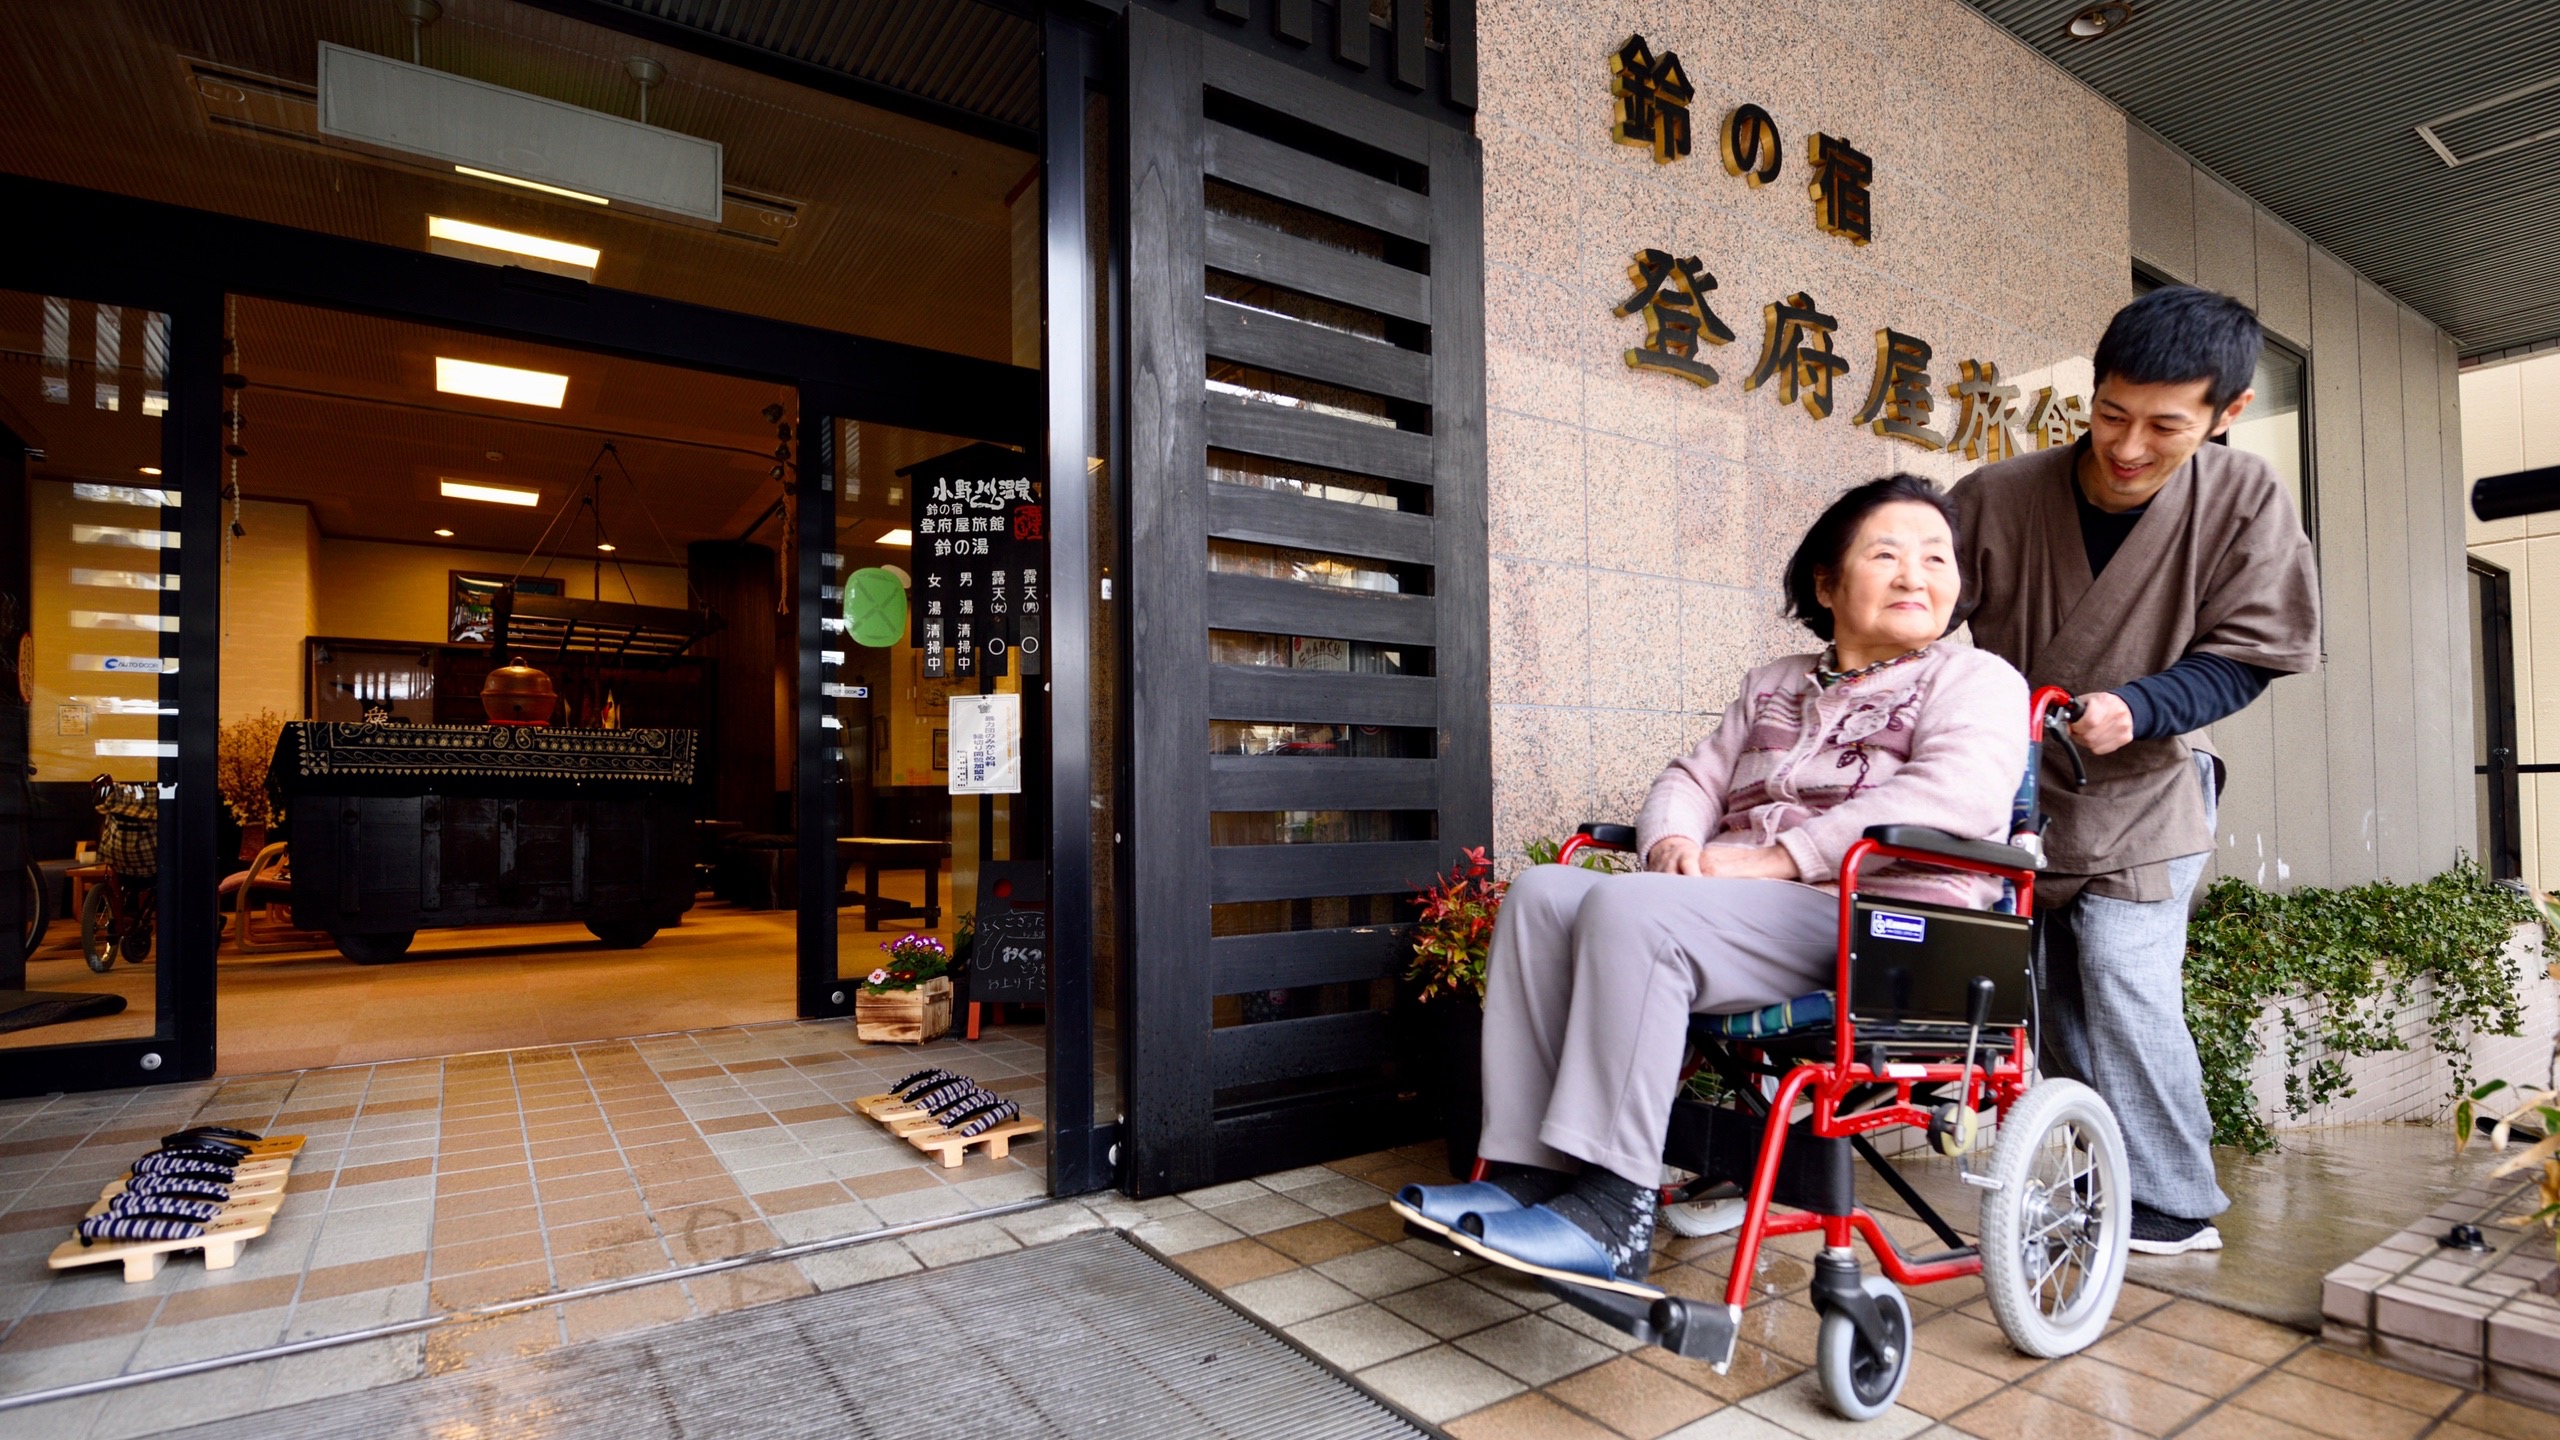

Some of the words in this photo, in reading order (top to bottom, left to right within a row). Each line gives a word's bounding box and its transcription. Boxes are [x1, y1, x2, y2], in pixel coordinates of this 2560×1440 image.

[1610, 33, 1872, 246] 鈴の宿
[932, 477, 1034, 510] 小野川温泉
[926, 503, 963, 516] 鈴の宿
[920, 516, 1005, 534] 登府屋旅館
[934, 538, 989, 556] 鈴の湯
[926, 623, 941, 671] 清掃中
[957, 623, 971, 670] 清掃中
[1002, 946, 1046, 963] おくつ
